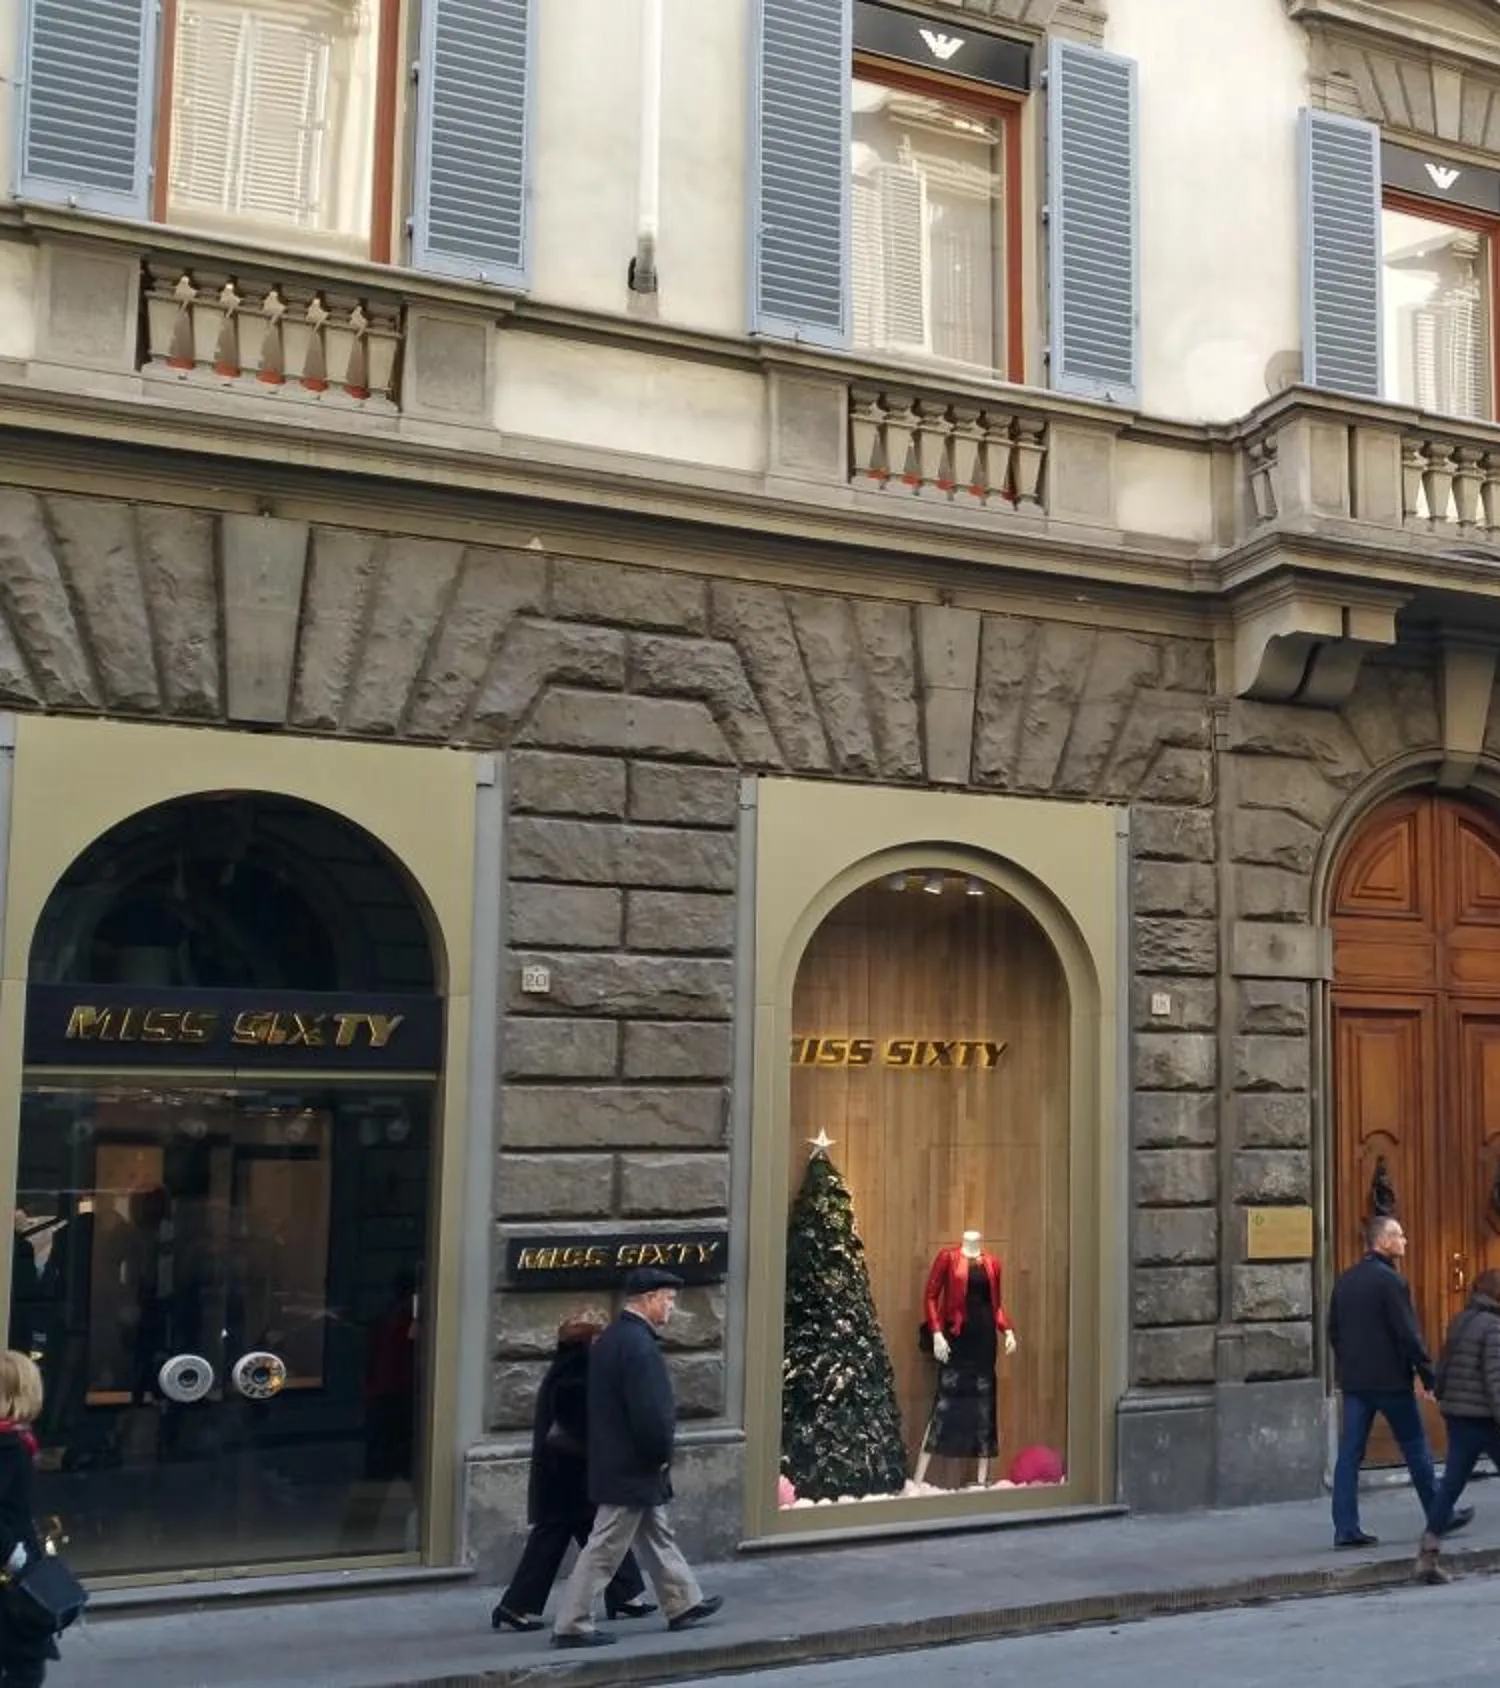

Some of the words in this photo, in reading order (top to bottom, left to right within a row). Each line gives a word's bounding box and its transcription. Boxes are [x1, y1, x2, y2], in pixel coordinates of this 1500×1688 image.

[65, 1005, 219, 1042] MISS
[230, 1010, 404, 1047] SIXTY
[886, 1040, 1009, 1067] SIXTY
[518, 1246, 608, 1270] MISS
[616, 1241, 719, 1267] SIXTY
